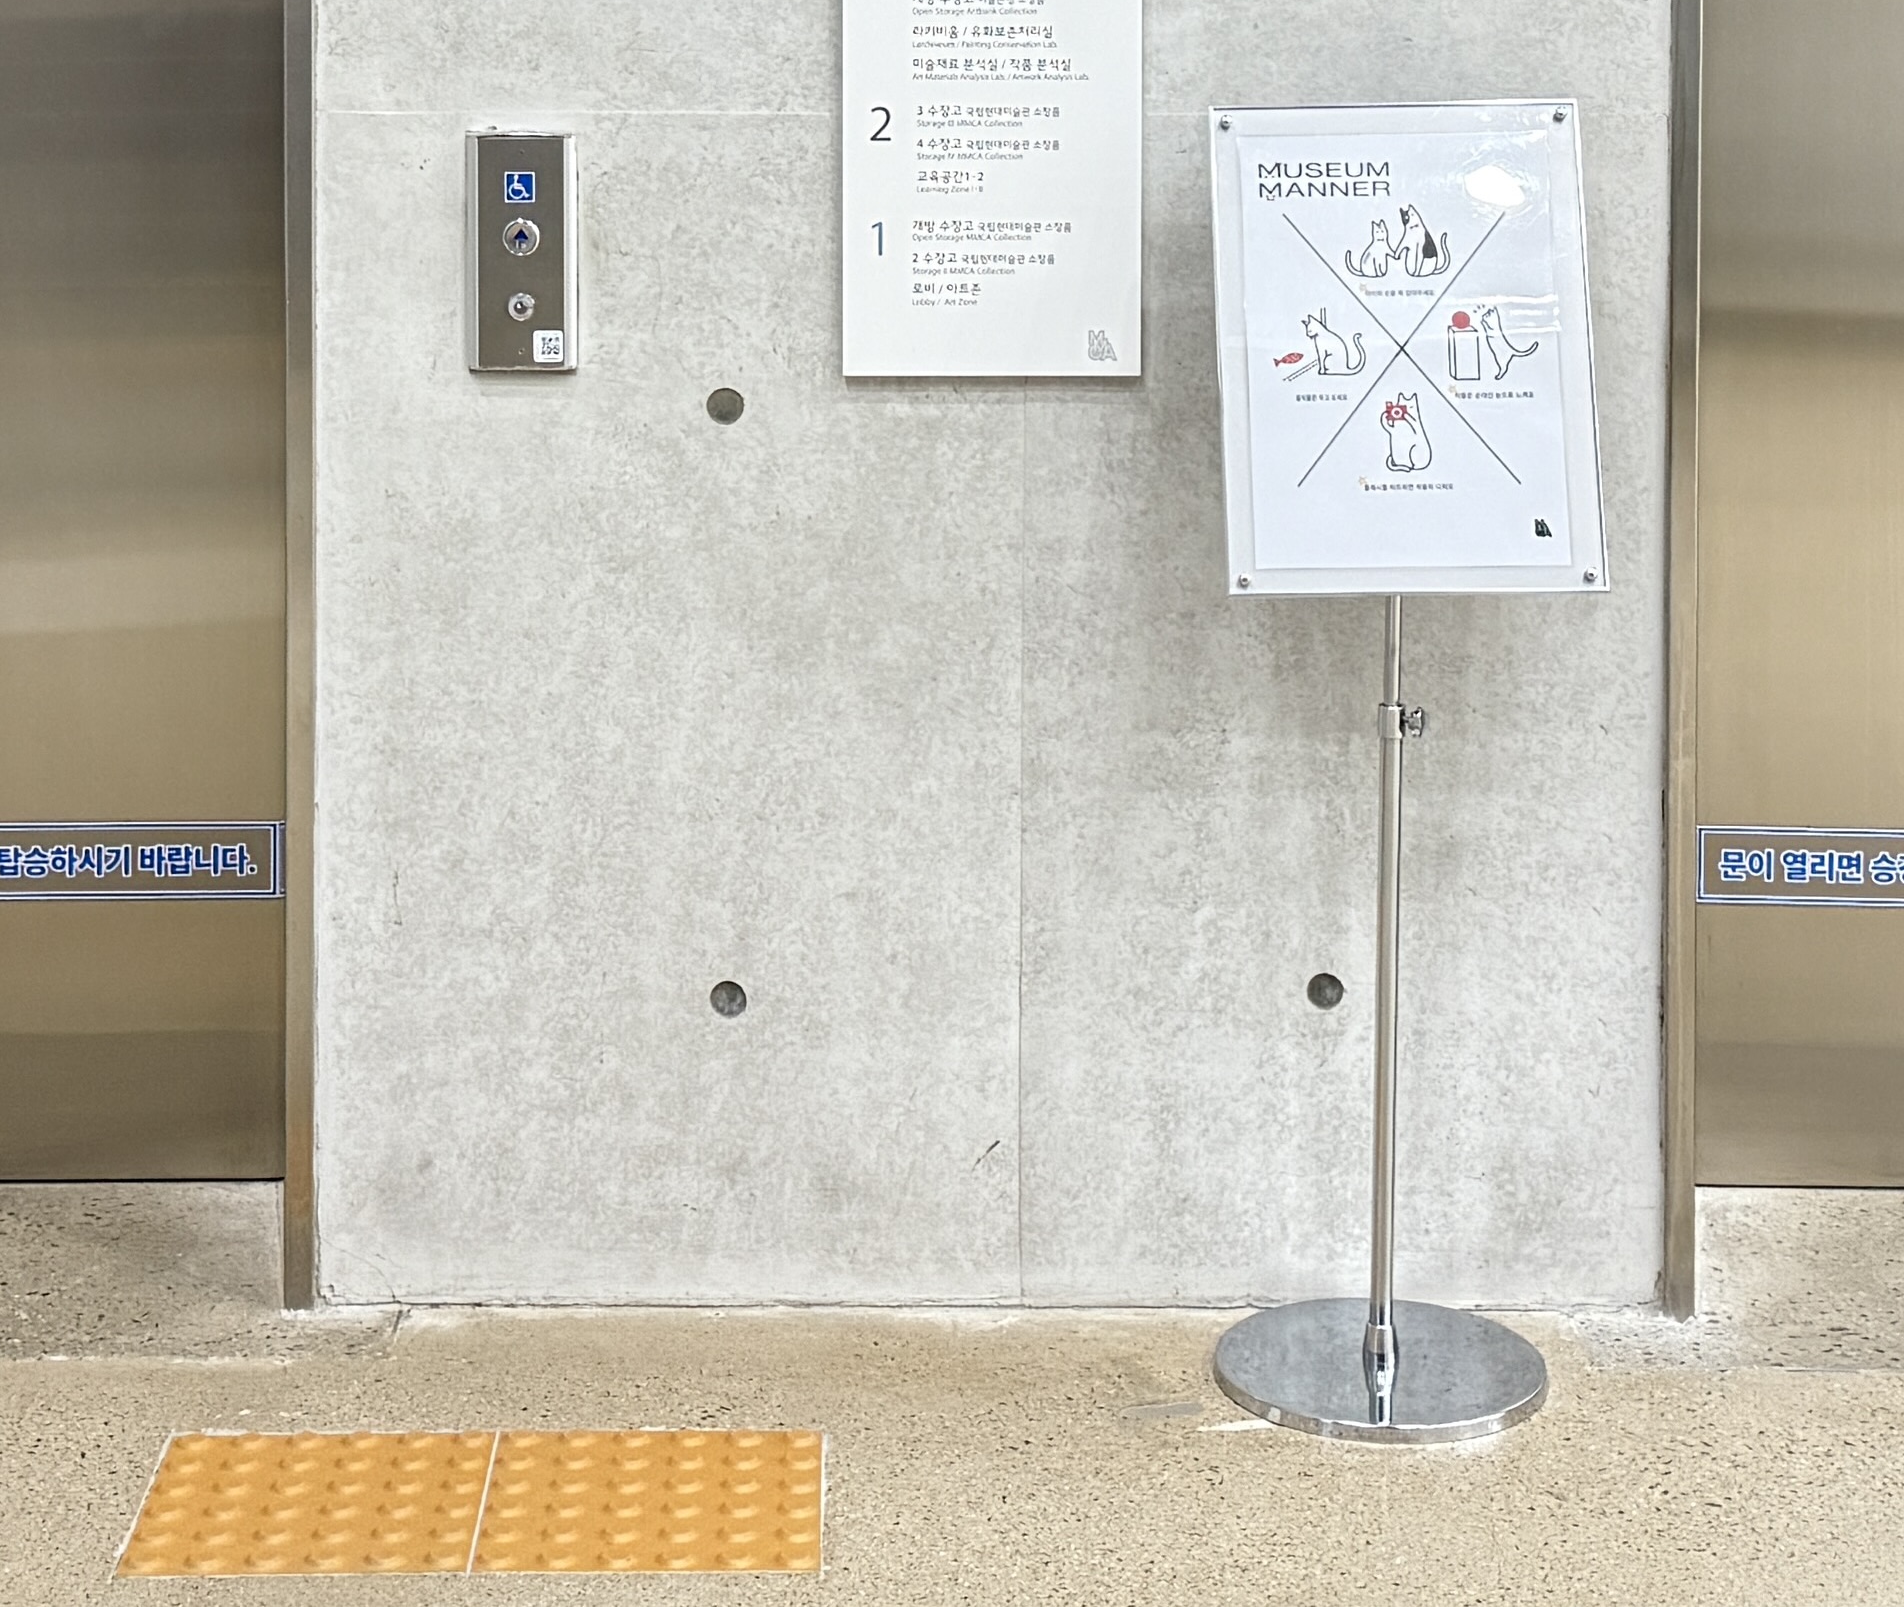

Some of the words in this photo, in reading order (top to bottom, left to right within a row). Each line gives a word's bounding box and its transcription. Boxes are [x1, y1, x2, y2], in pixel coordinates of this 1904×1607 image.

[917, 106, 923, 116] 3
[870, 106, 892, 142] 2
[917, 139, 923, 148] 4
[1258, 162, 1390, 178] MUSEUM
[1259, 181, 1390, 198] MANNER
[871, 222, 883, 256] 1
[912, 253, 918, 263] 2
[138, 844, 258, 878] 바랍니다.
[1718, 850, 1775, 883] 문이
[1781, 851, 1864, 884] 열리면
